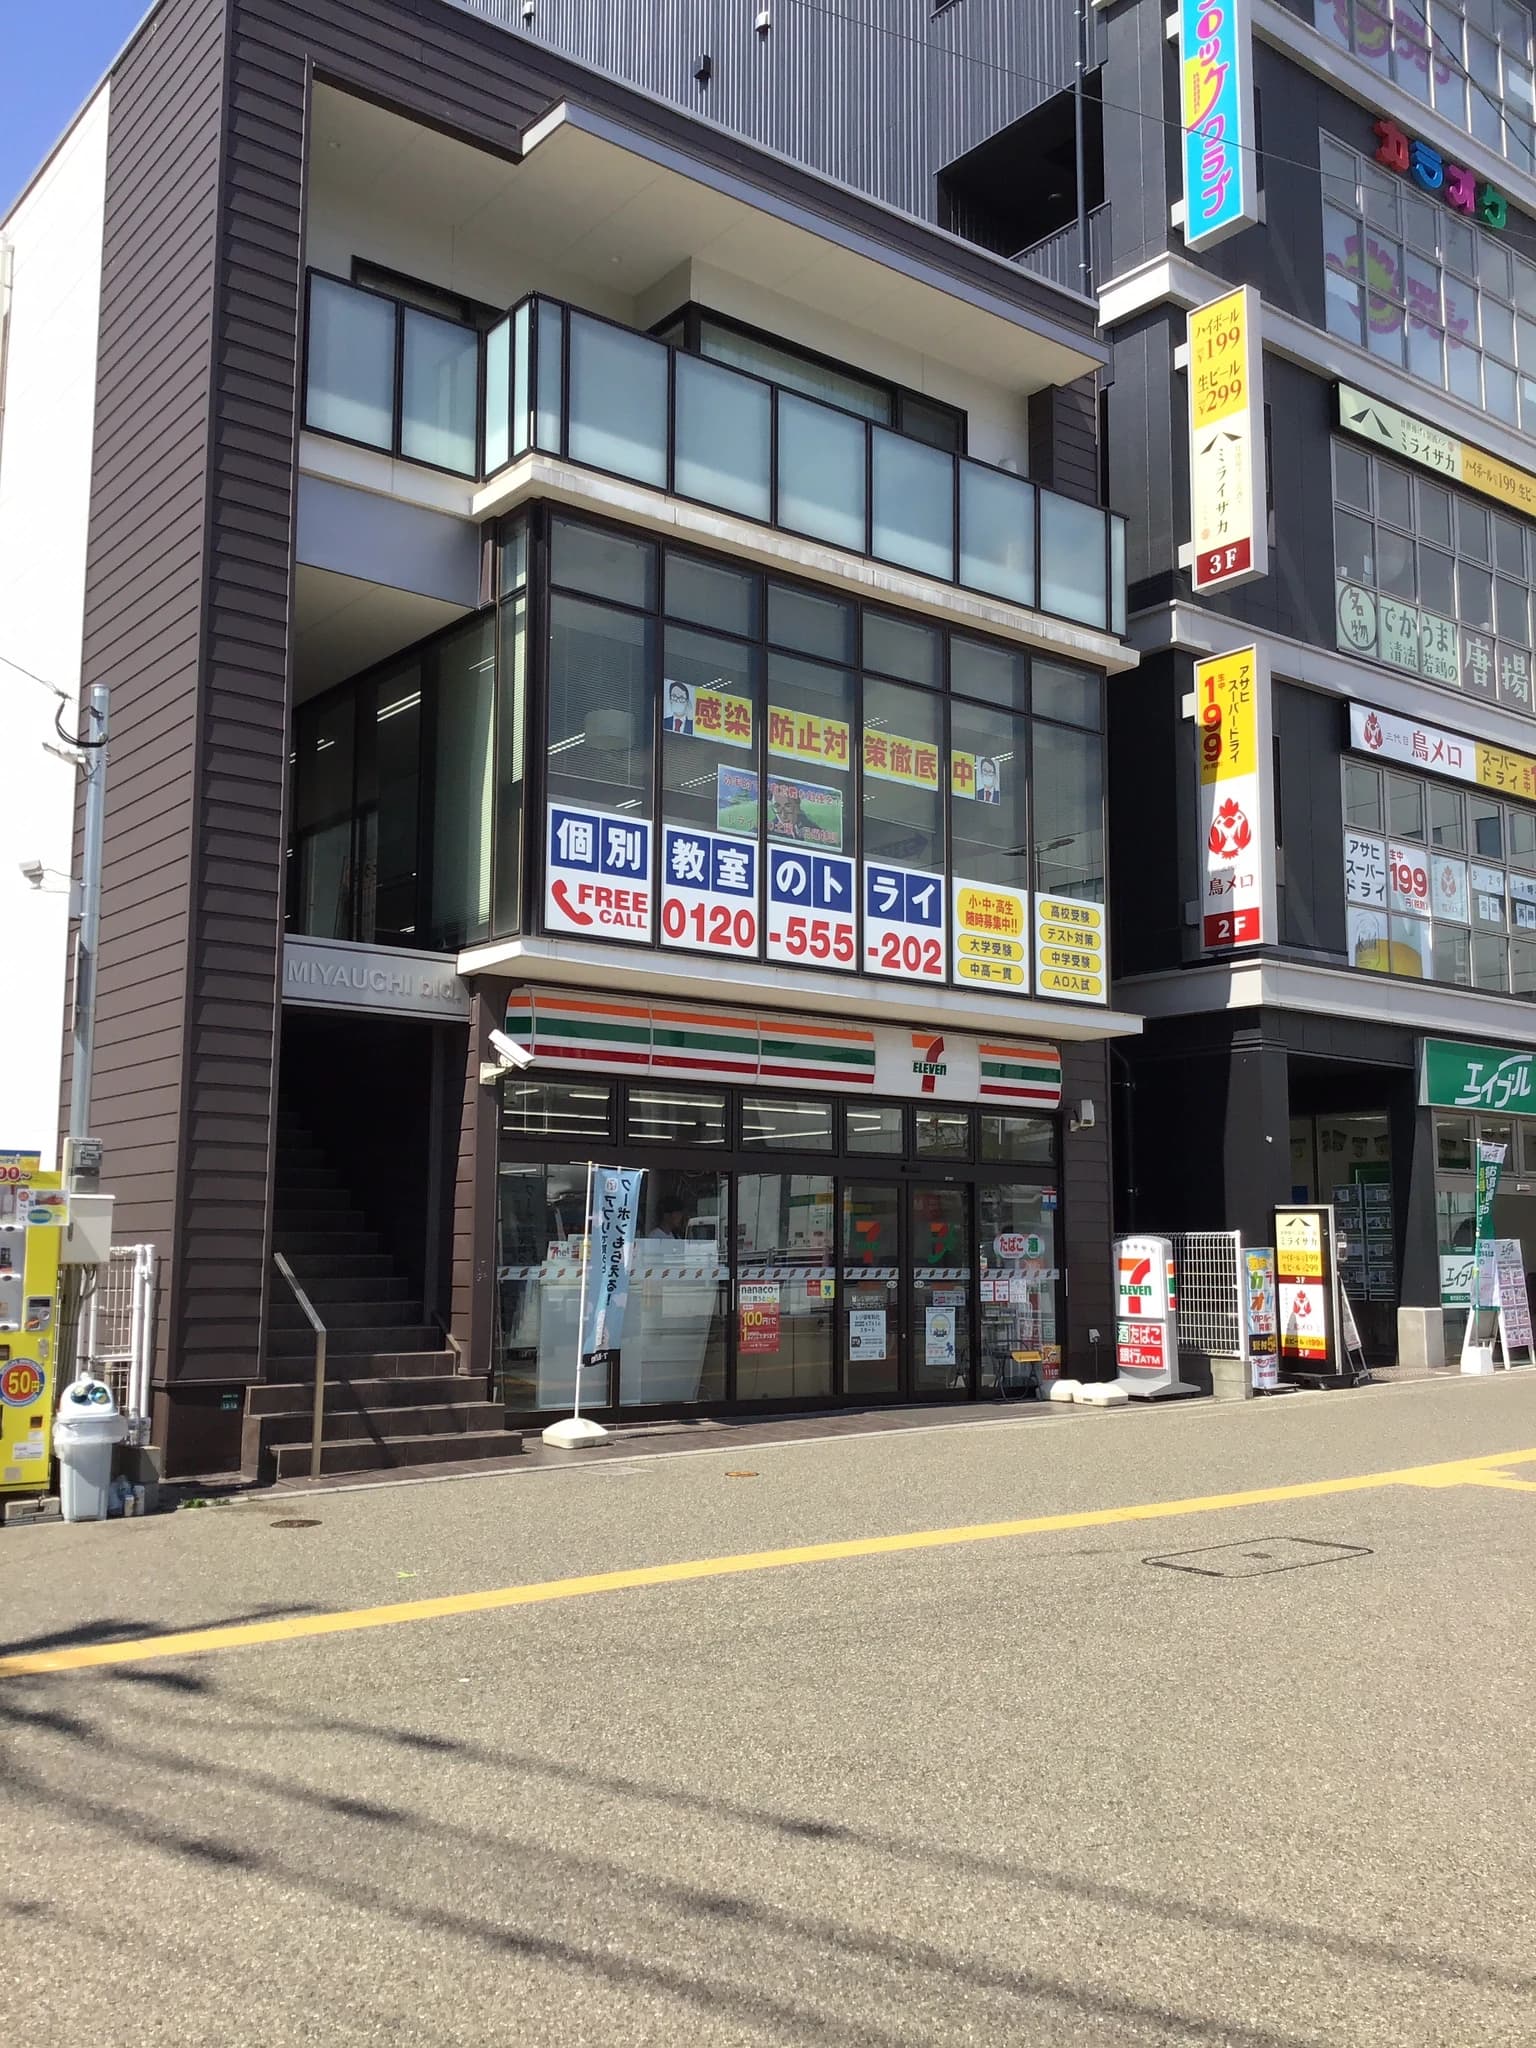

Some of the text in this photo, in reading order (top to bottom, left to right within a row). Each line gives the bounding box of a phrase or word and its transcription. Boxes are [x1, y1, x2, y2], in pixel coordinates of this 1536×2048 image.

[1198, 360, 1241, 394] 生ビール
[1401, 431, 1455, 473] ミライザカ
[1216, 447, 1229, 536] ミライザカ
[1209, 547, 1238, 576] 3F
[1351, 589, 1369, 643] 名物
[1239, 665, 1250, 702] アサヒ
[1203, 675, 1222, 762] 199
[1228, 680, 1240, 763] スーパードライ
[1411, 730, 1463, 769] 鳥メロ
[1482, 749, 1518, 769] スーパー
[1482, 767, 1518, 790] ドライ
[1349, 839, 1380, 860] アサヒ
[556, 817, 936, 919] 個別教室のトライ
[1346, 859, 1385, 879] スーパー
[1208, 873, 1254, 897] 鳥メロ
[1346, 878, 1385, 902] ドライ
[1389, 863, 1428, 898] 199
[577, 883, 648, 914] FREE
[599, 908, 648, 930] CALL
[1051, 905, 1090, 924] 高校受験
[662, 897, 942, 975] 0120-555-202
[1047, 928, 1094, 947] テスト対策
[1218, 916, 1246, 939] 2F
[970, 938, 1012, 957] 大学受験
[970, 963, 1012, 981] 中高一貫
[1051, 951, 1090, 969] 中学受験
[287, 959, 413, 997] MIYAUCHI
[1053, 975, 1090, 992] AO入試
[1454, 1054, 1533, 1108] エイブル
[1000, 1238, 1024, 1252] たばこ
[1295, 1276, 1306, 1284] 3F
[1129, 1326, 1162, 1345] たばこ
[1119, 1347, 1162, 1365] 銀行ATM
